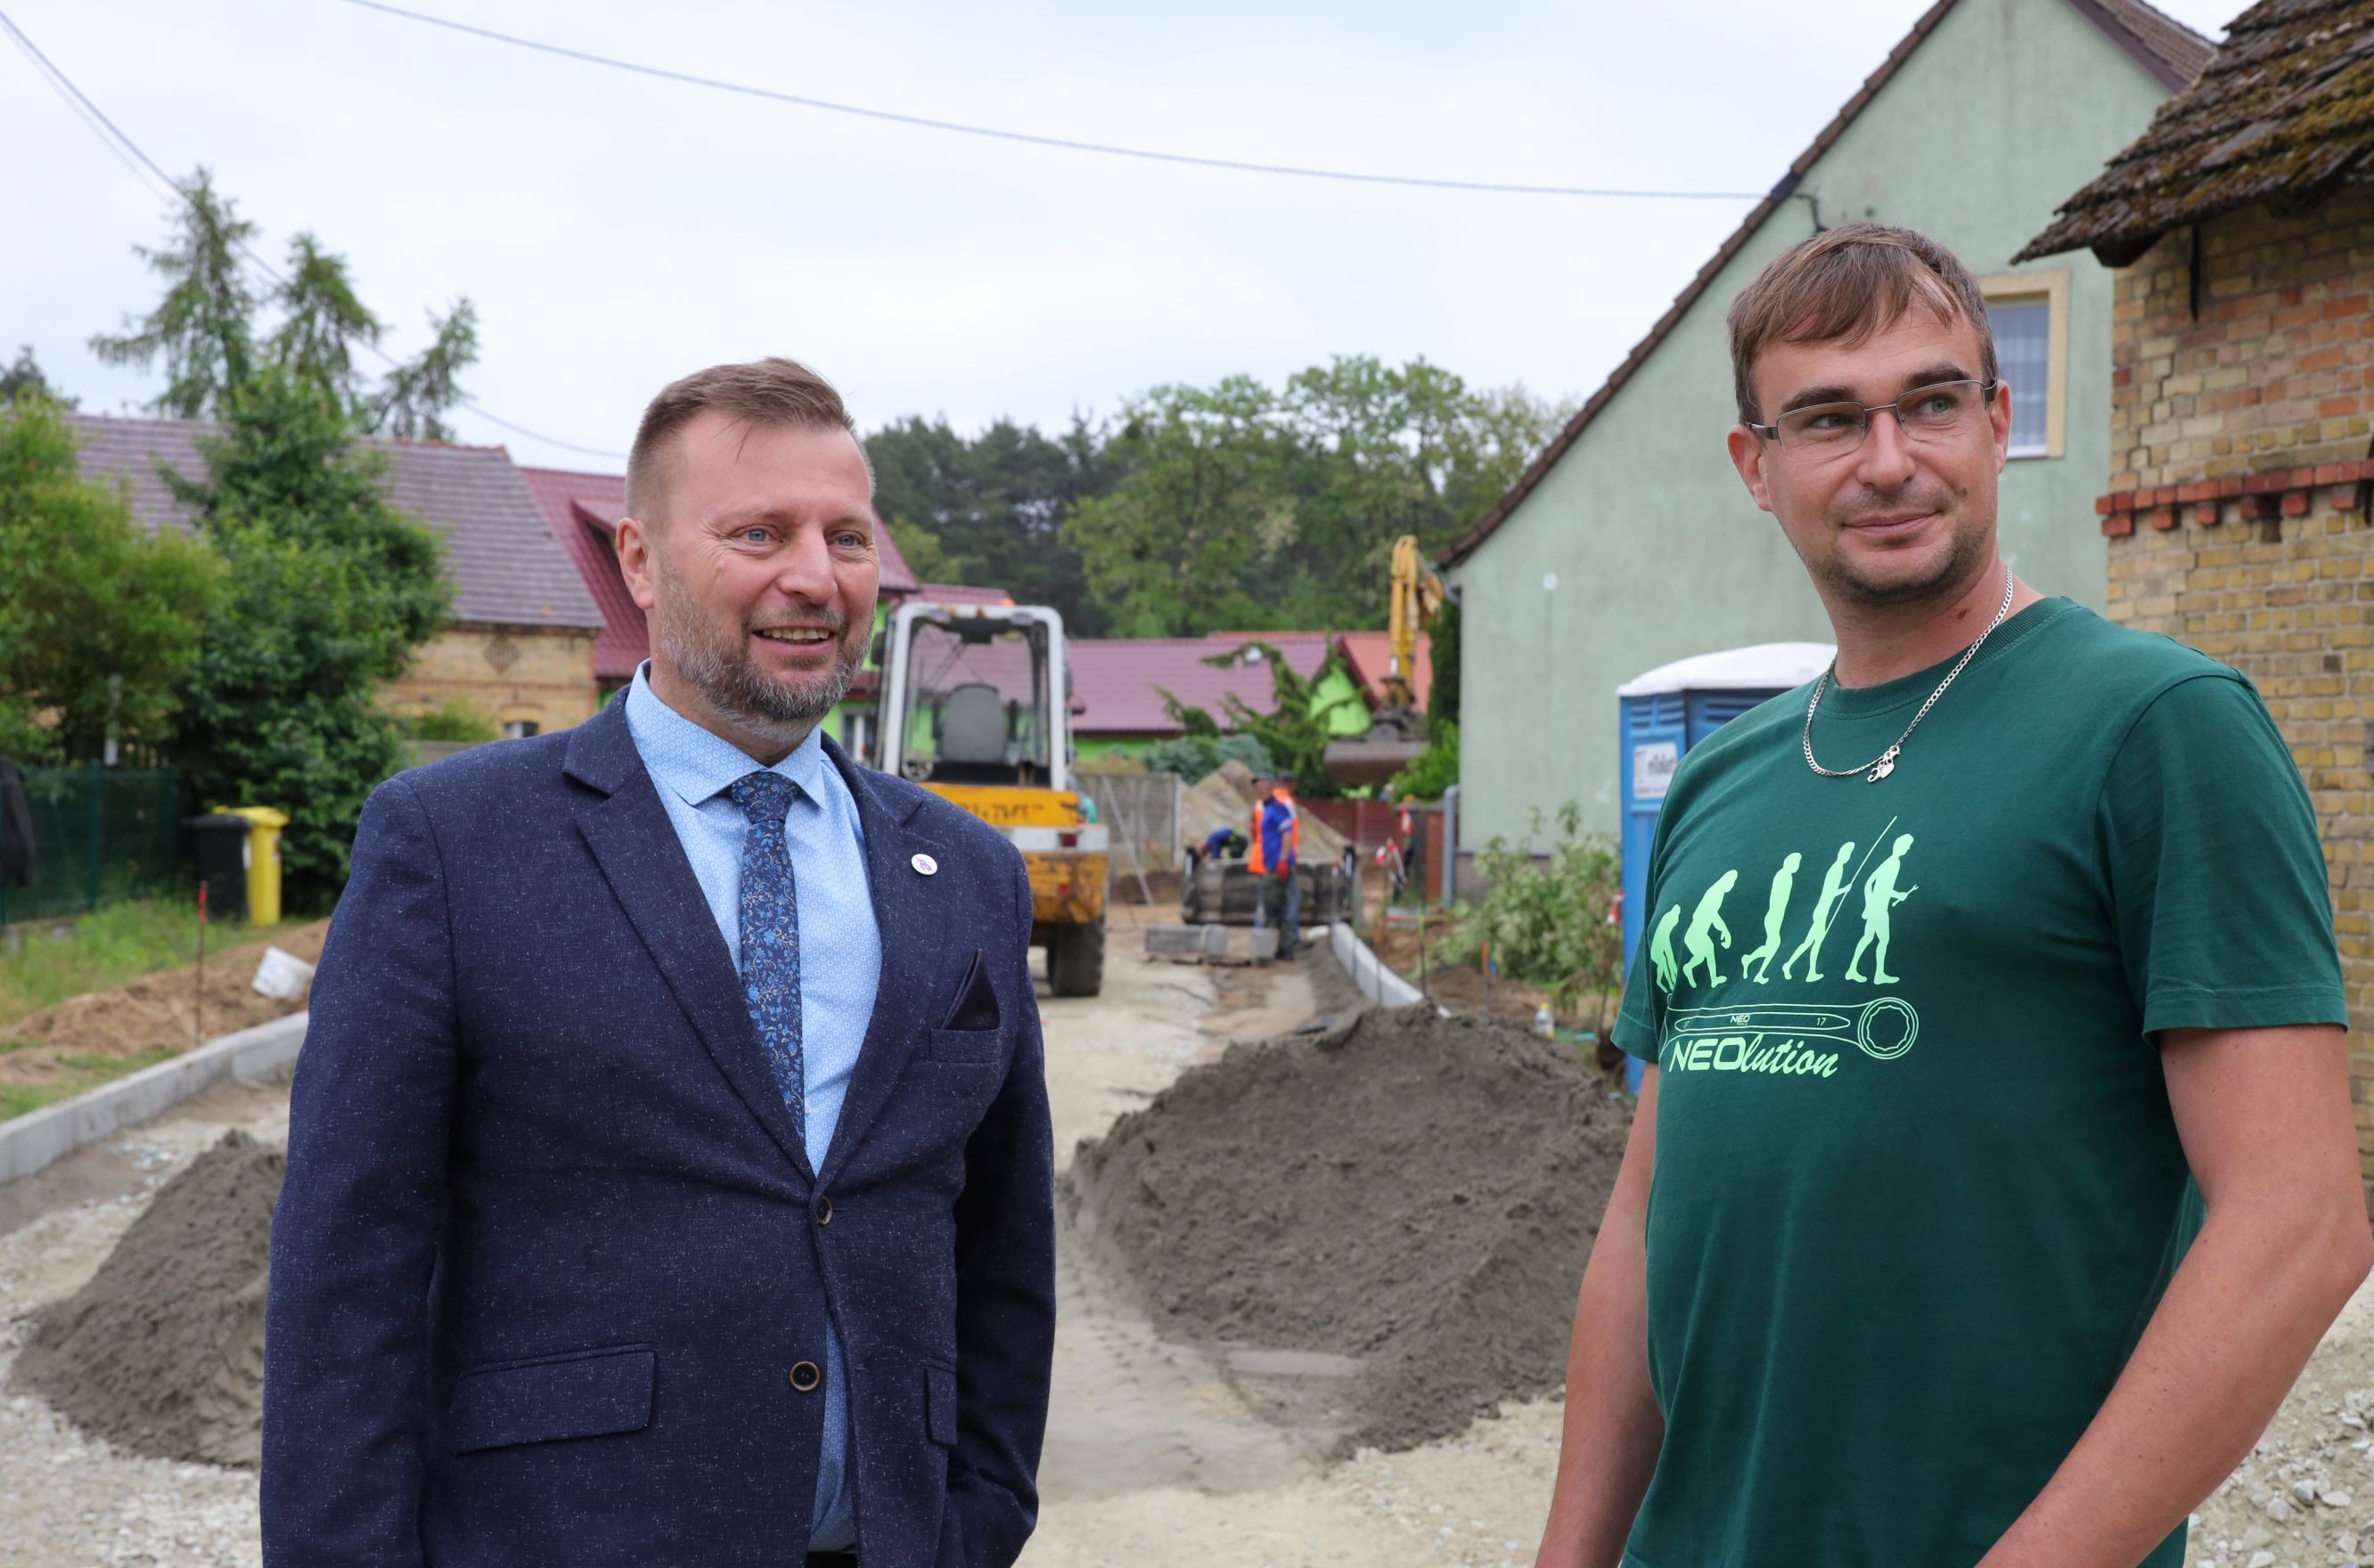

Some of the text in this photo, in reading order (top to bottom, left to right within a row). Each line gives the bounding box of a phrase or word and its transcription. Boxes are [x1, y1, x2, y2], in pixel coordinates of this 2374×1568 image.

[1730, 1015, 1751, 1024] NEO
[1816, 1017, 1827, 1026] 17
[1669, 1033, 1838, 1078] NEOlution
